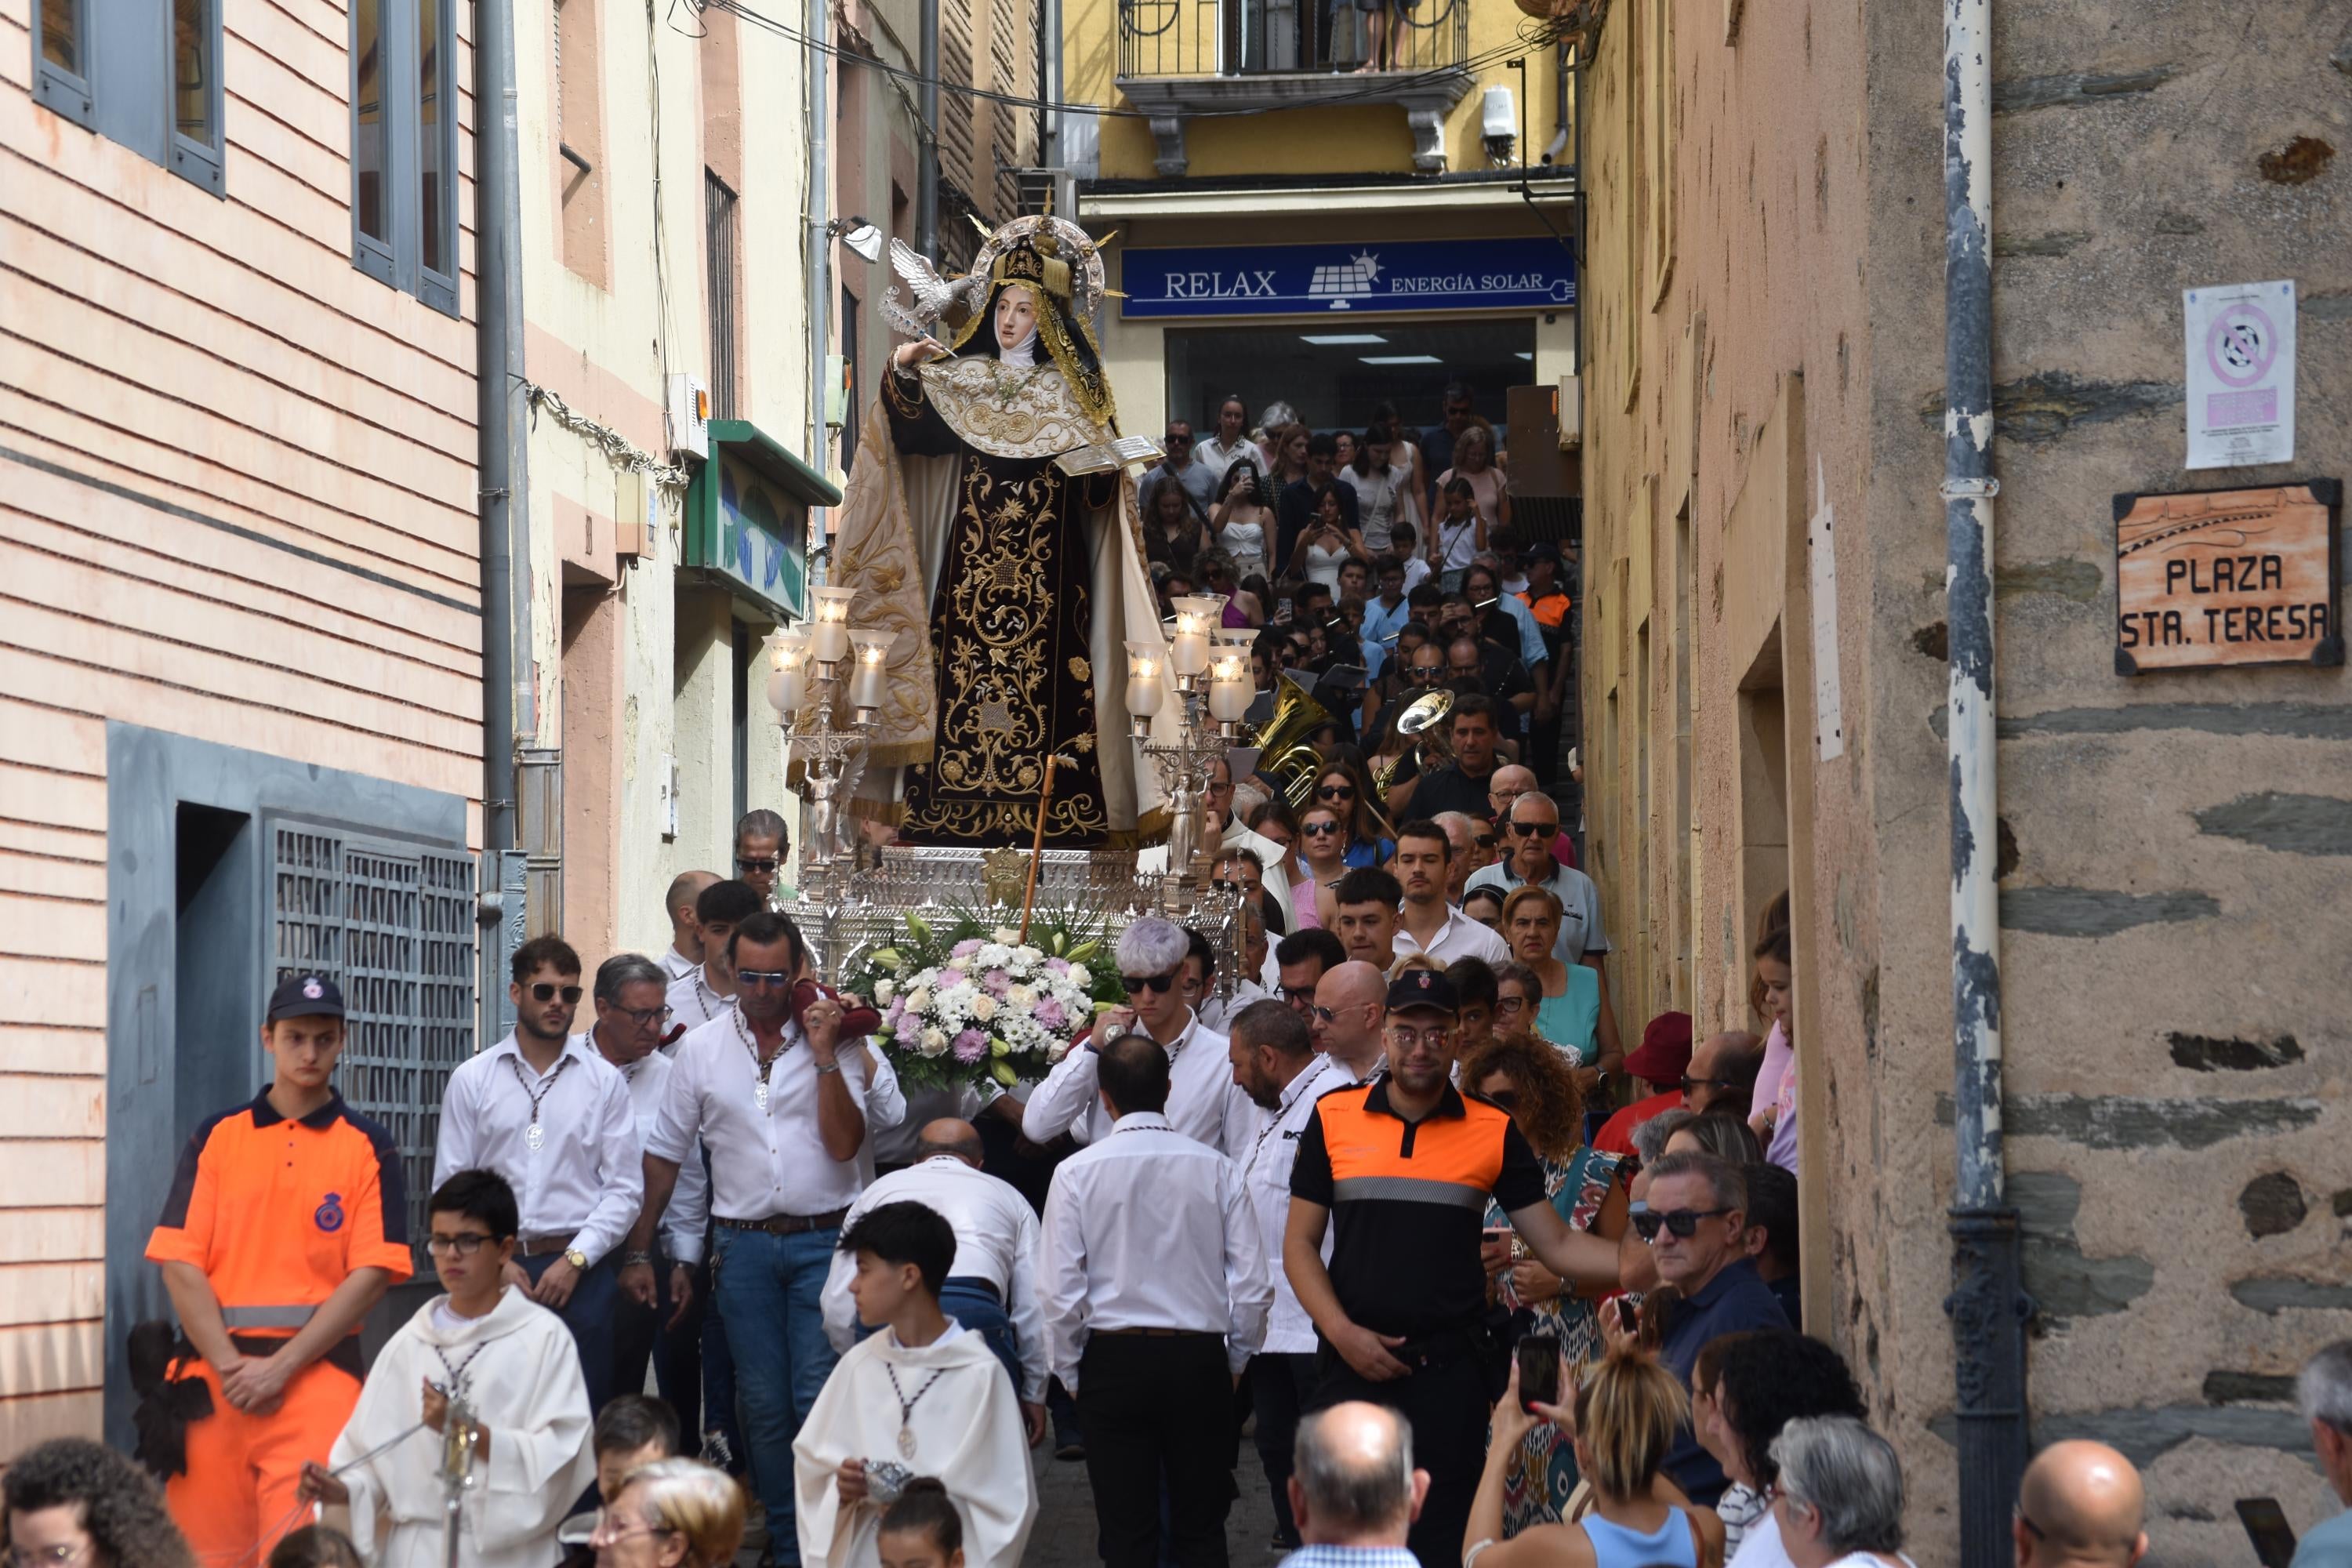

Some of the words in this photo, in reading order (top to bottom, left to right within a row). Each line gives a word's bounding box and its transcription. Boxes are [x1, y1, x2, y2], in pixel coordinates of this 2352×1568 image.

[1165, 270, 1277, 298] RELAX
[1391, 273, 1475, 293] ENERGÍA
[1481, 273, 1543, 290] SOLAR
[2166, 554, 2281, 595] PLAZA
[2121, 610, 2191, 648] STA.
[2203, 603, 2328, 644] TERESA
